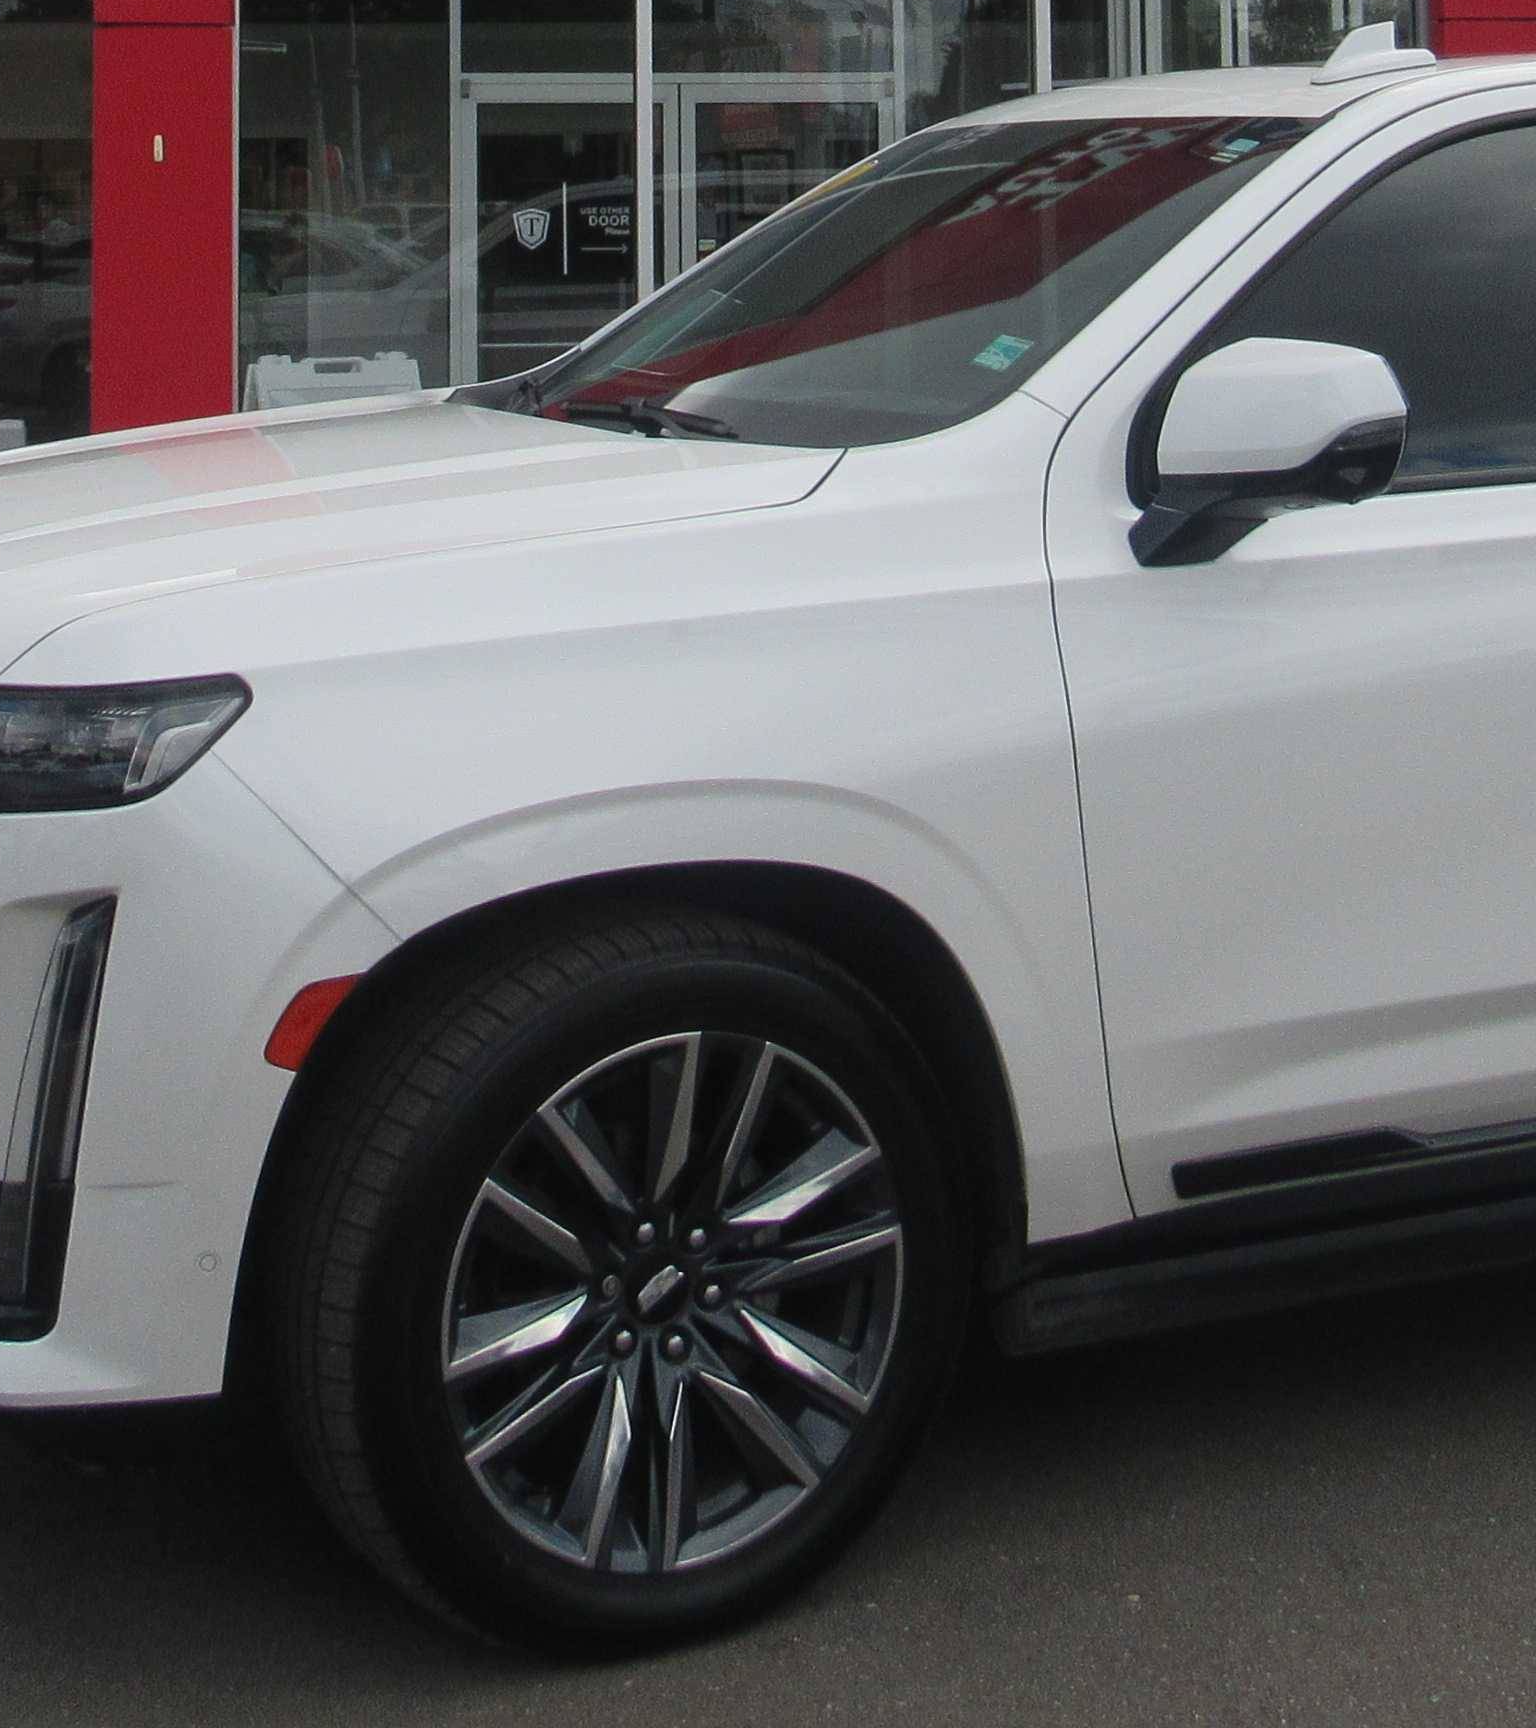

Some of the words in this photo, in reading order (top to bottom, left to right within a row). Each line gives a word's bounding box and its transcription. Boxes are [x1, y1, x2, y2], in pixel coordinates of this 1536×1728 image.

[580, 207, 597, 215] USE
[599, 206, 631, 214] OTHER
[525, 217, 540, 237] T
[588, 215, 630, 227] DOOR
